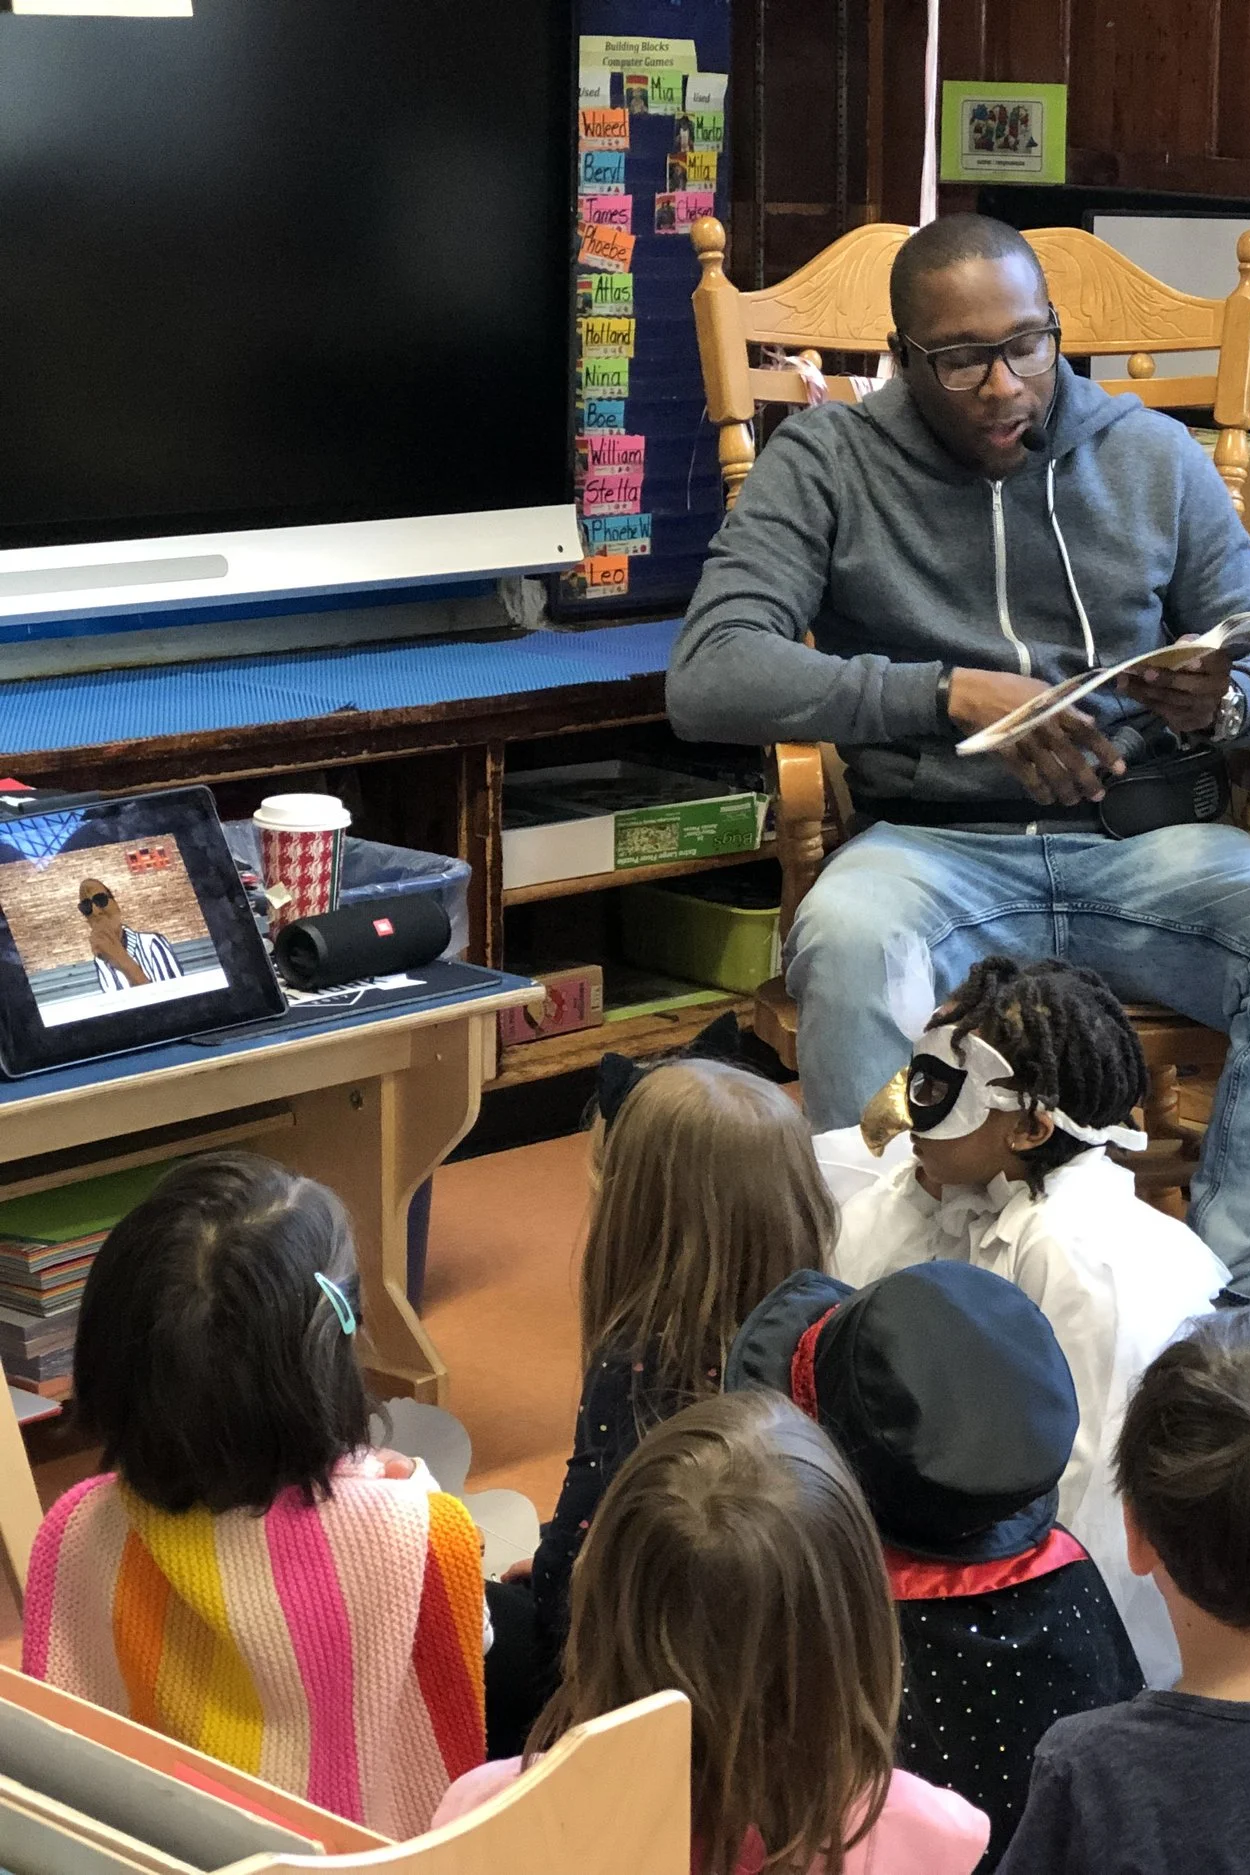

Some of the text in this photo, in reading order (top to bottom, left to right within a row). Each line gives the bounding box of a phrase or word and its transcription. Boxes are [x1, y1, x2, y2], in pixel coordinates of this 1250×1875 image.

[605, 41, 670, 53] Building Blocks
[602, 57, 674, 68] Computer Games
[651, 75, 674, 102] Mia
[585, 198, 630, 224] James
[582, 224, 627, 261] Phoebe
[594, 275, 632, 304] Atlas
[586, 321, 632, 346] Holland
[585, 364, 621, 388] Nina
[587, 402, 618, 427] Boe
[588, 438, 642, 466] William
[585, 475, 640, 505] Stella
[590, 563, 625, 587] Leo
[714, 832, 753, 847] Bugs
